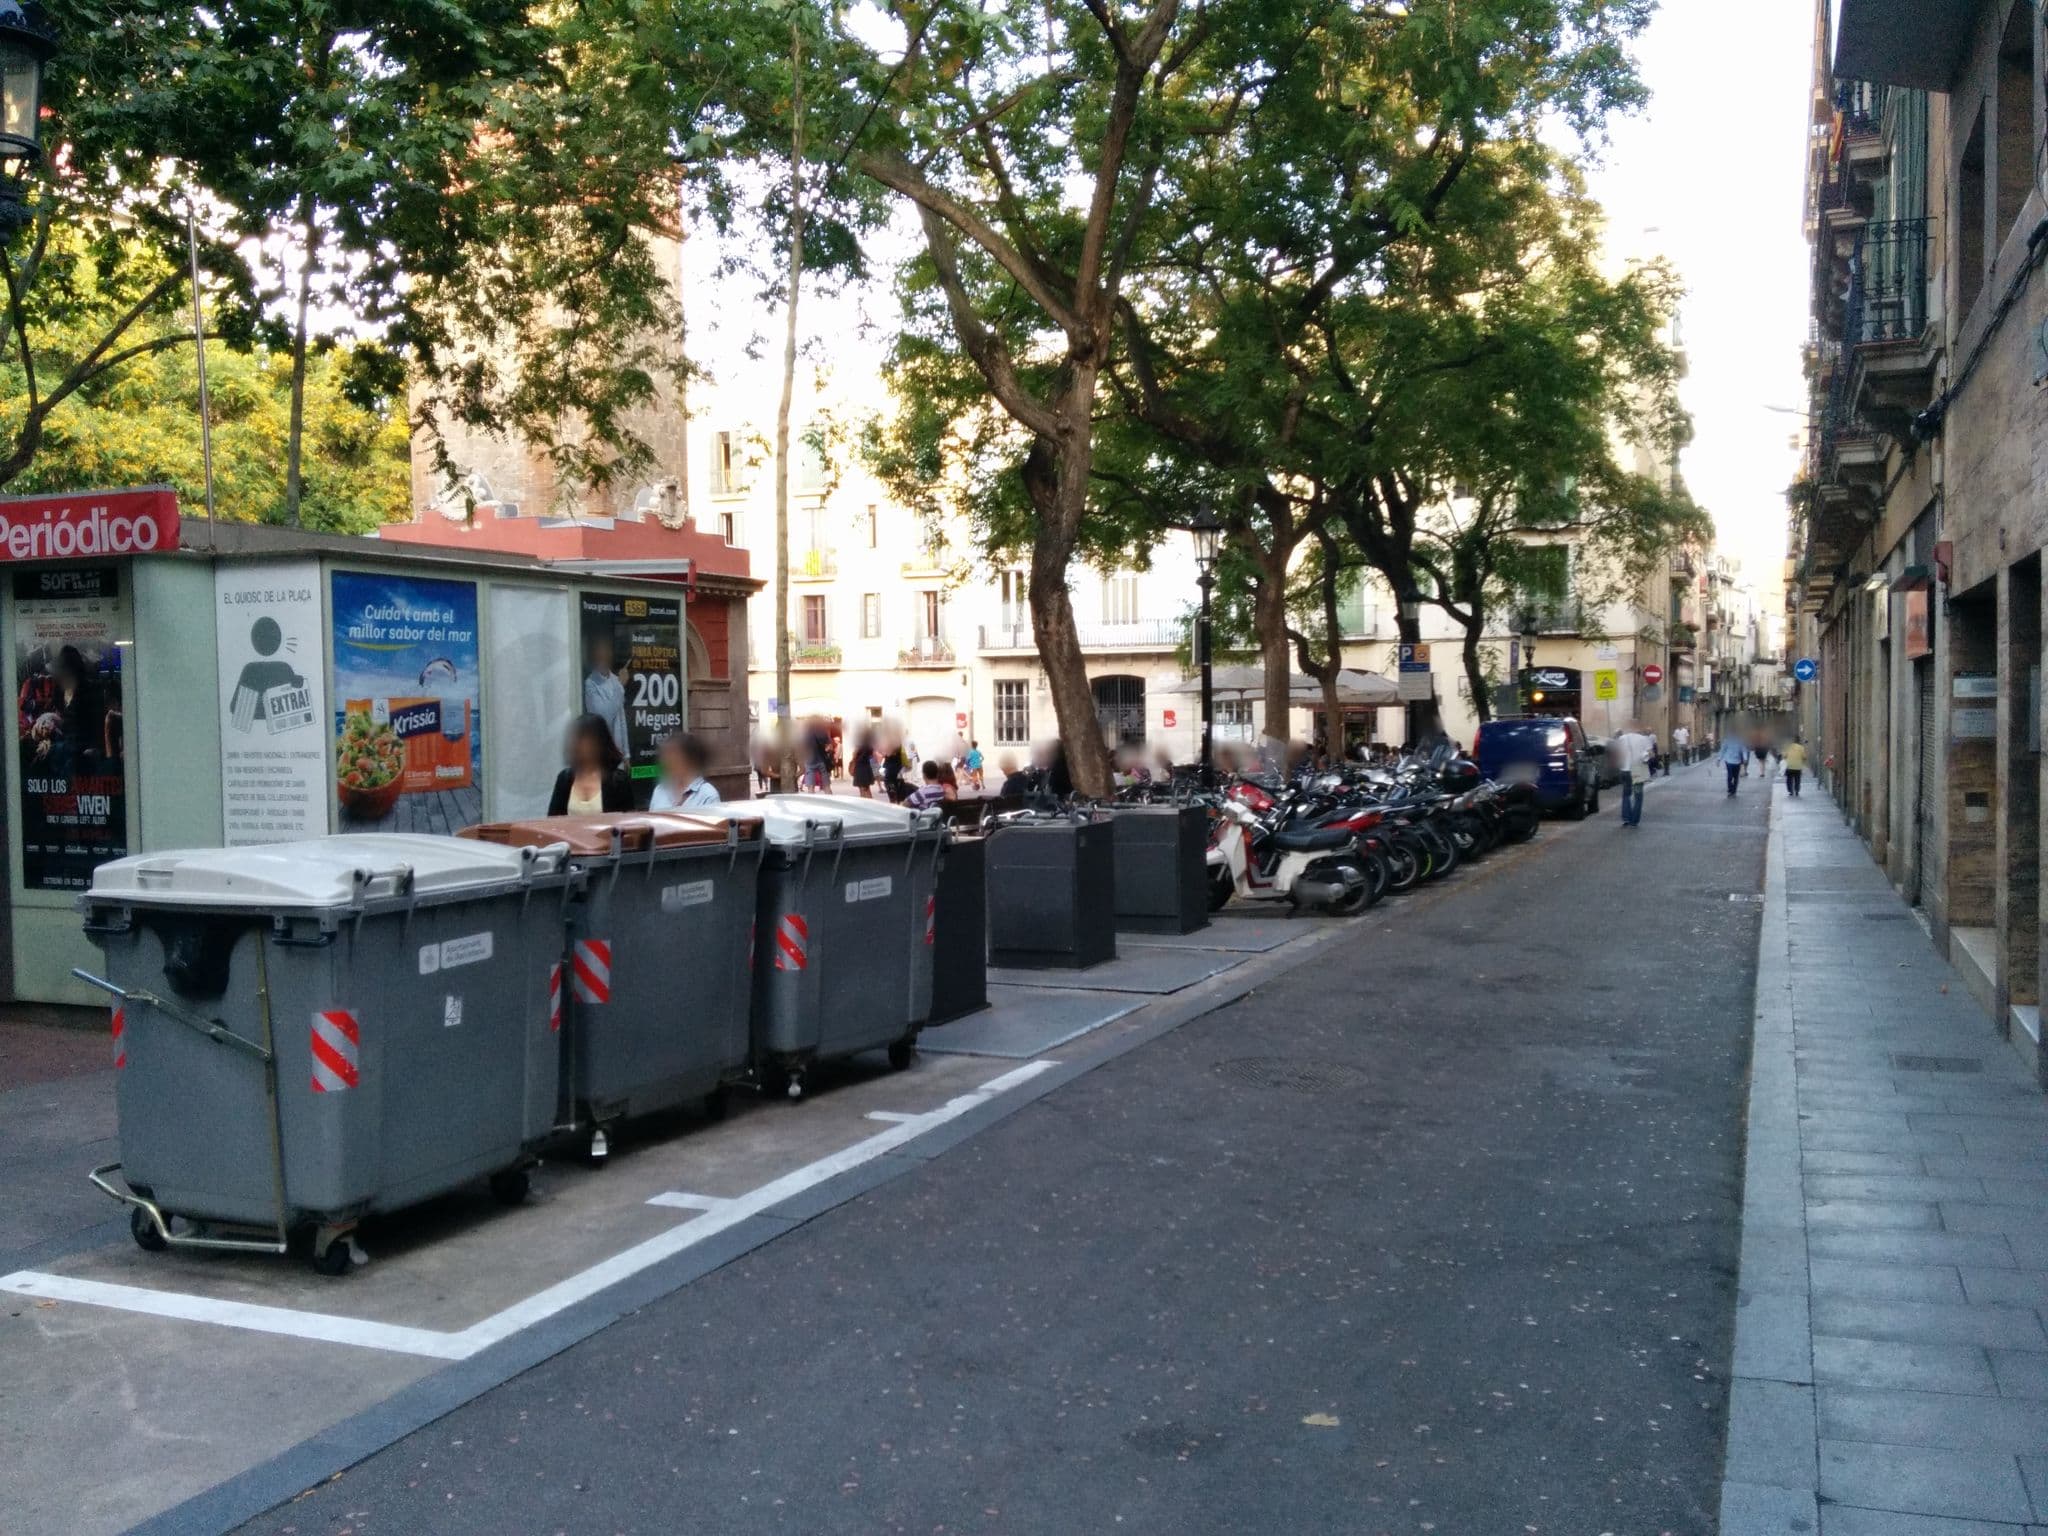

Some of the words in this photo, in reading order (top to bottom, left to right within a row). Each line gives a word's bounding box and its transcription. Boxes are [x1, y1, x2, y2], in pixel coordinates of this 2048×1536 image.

[223, 592, 233, 604] EL
[234, 591, 261, 605] QUIOSC
[264, 591, 275, 603] DE
[276, 590, 287, 603] LA
[288, 589, 312, 604] PLAÇA
[413, 608, 440, 624] amb
[442, 608, 455, 624] el
[348, 623, 387, 641] millor
[388, 625, 424, 642] sabor
[427, 626, 446, 642] del
[448, 630, 472, 643] mar
[1401, 646, 1412, 660] P
[632, 672, 679, 708] 200
[271, 689, 310, 715] EXTRA!
[393, 710, 436, 735] Krissia
[635, 710, 681, 731] Megues
[28, 779, 47, 794] SOLO
[51, 780, 67, 794] LOS
